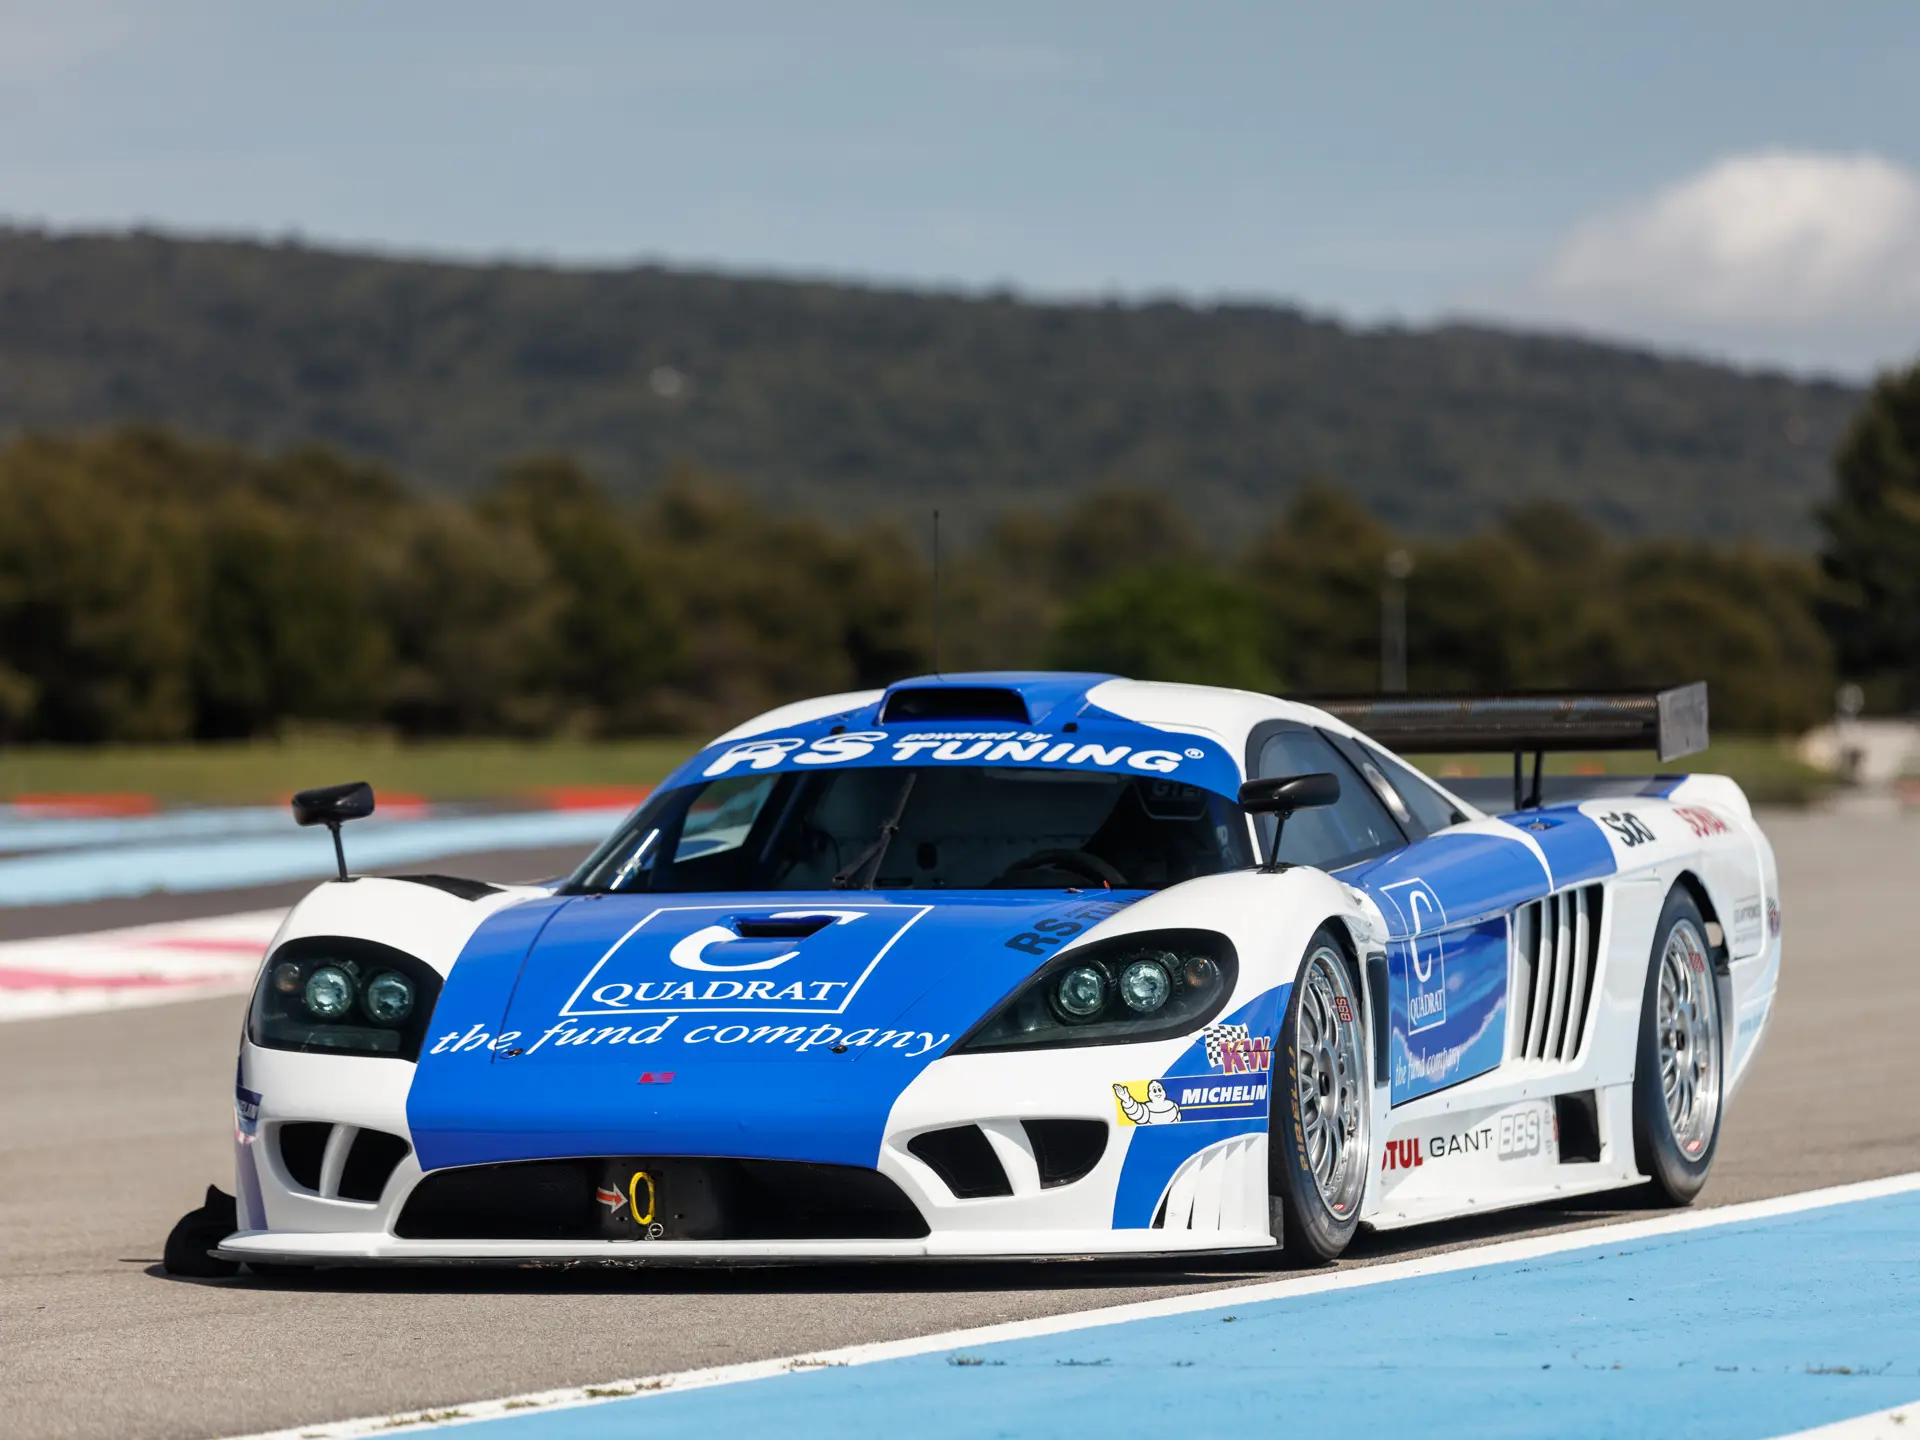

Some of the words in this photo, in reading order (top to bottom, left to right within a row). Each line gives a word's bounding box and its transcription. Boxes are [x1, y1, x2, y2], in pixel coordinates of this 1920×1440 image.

[899, 731, 1018, 743] powered
[1016, 731, 1053, 743] by
[1004, 918, 1083, 956] RS
[592, 981, 847, 1006] QUADRAT
[1410, 989, 1444, 1026] QUADRAT
[430, 1024, 521, 1055] the
[526, 1016, 679, 1055] fund
[683, 1024, 949, 1058] company
[1219, 1037, 1270, 1075] KW
[1181, 1085, 1267, 1105] MICHELIN
[1429, 1129, 1492, 1158] GANT
[1498, 1110, 1540, 1161] BBS
